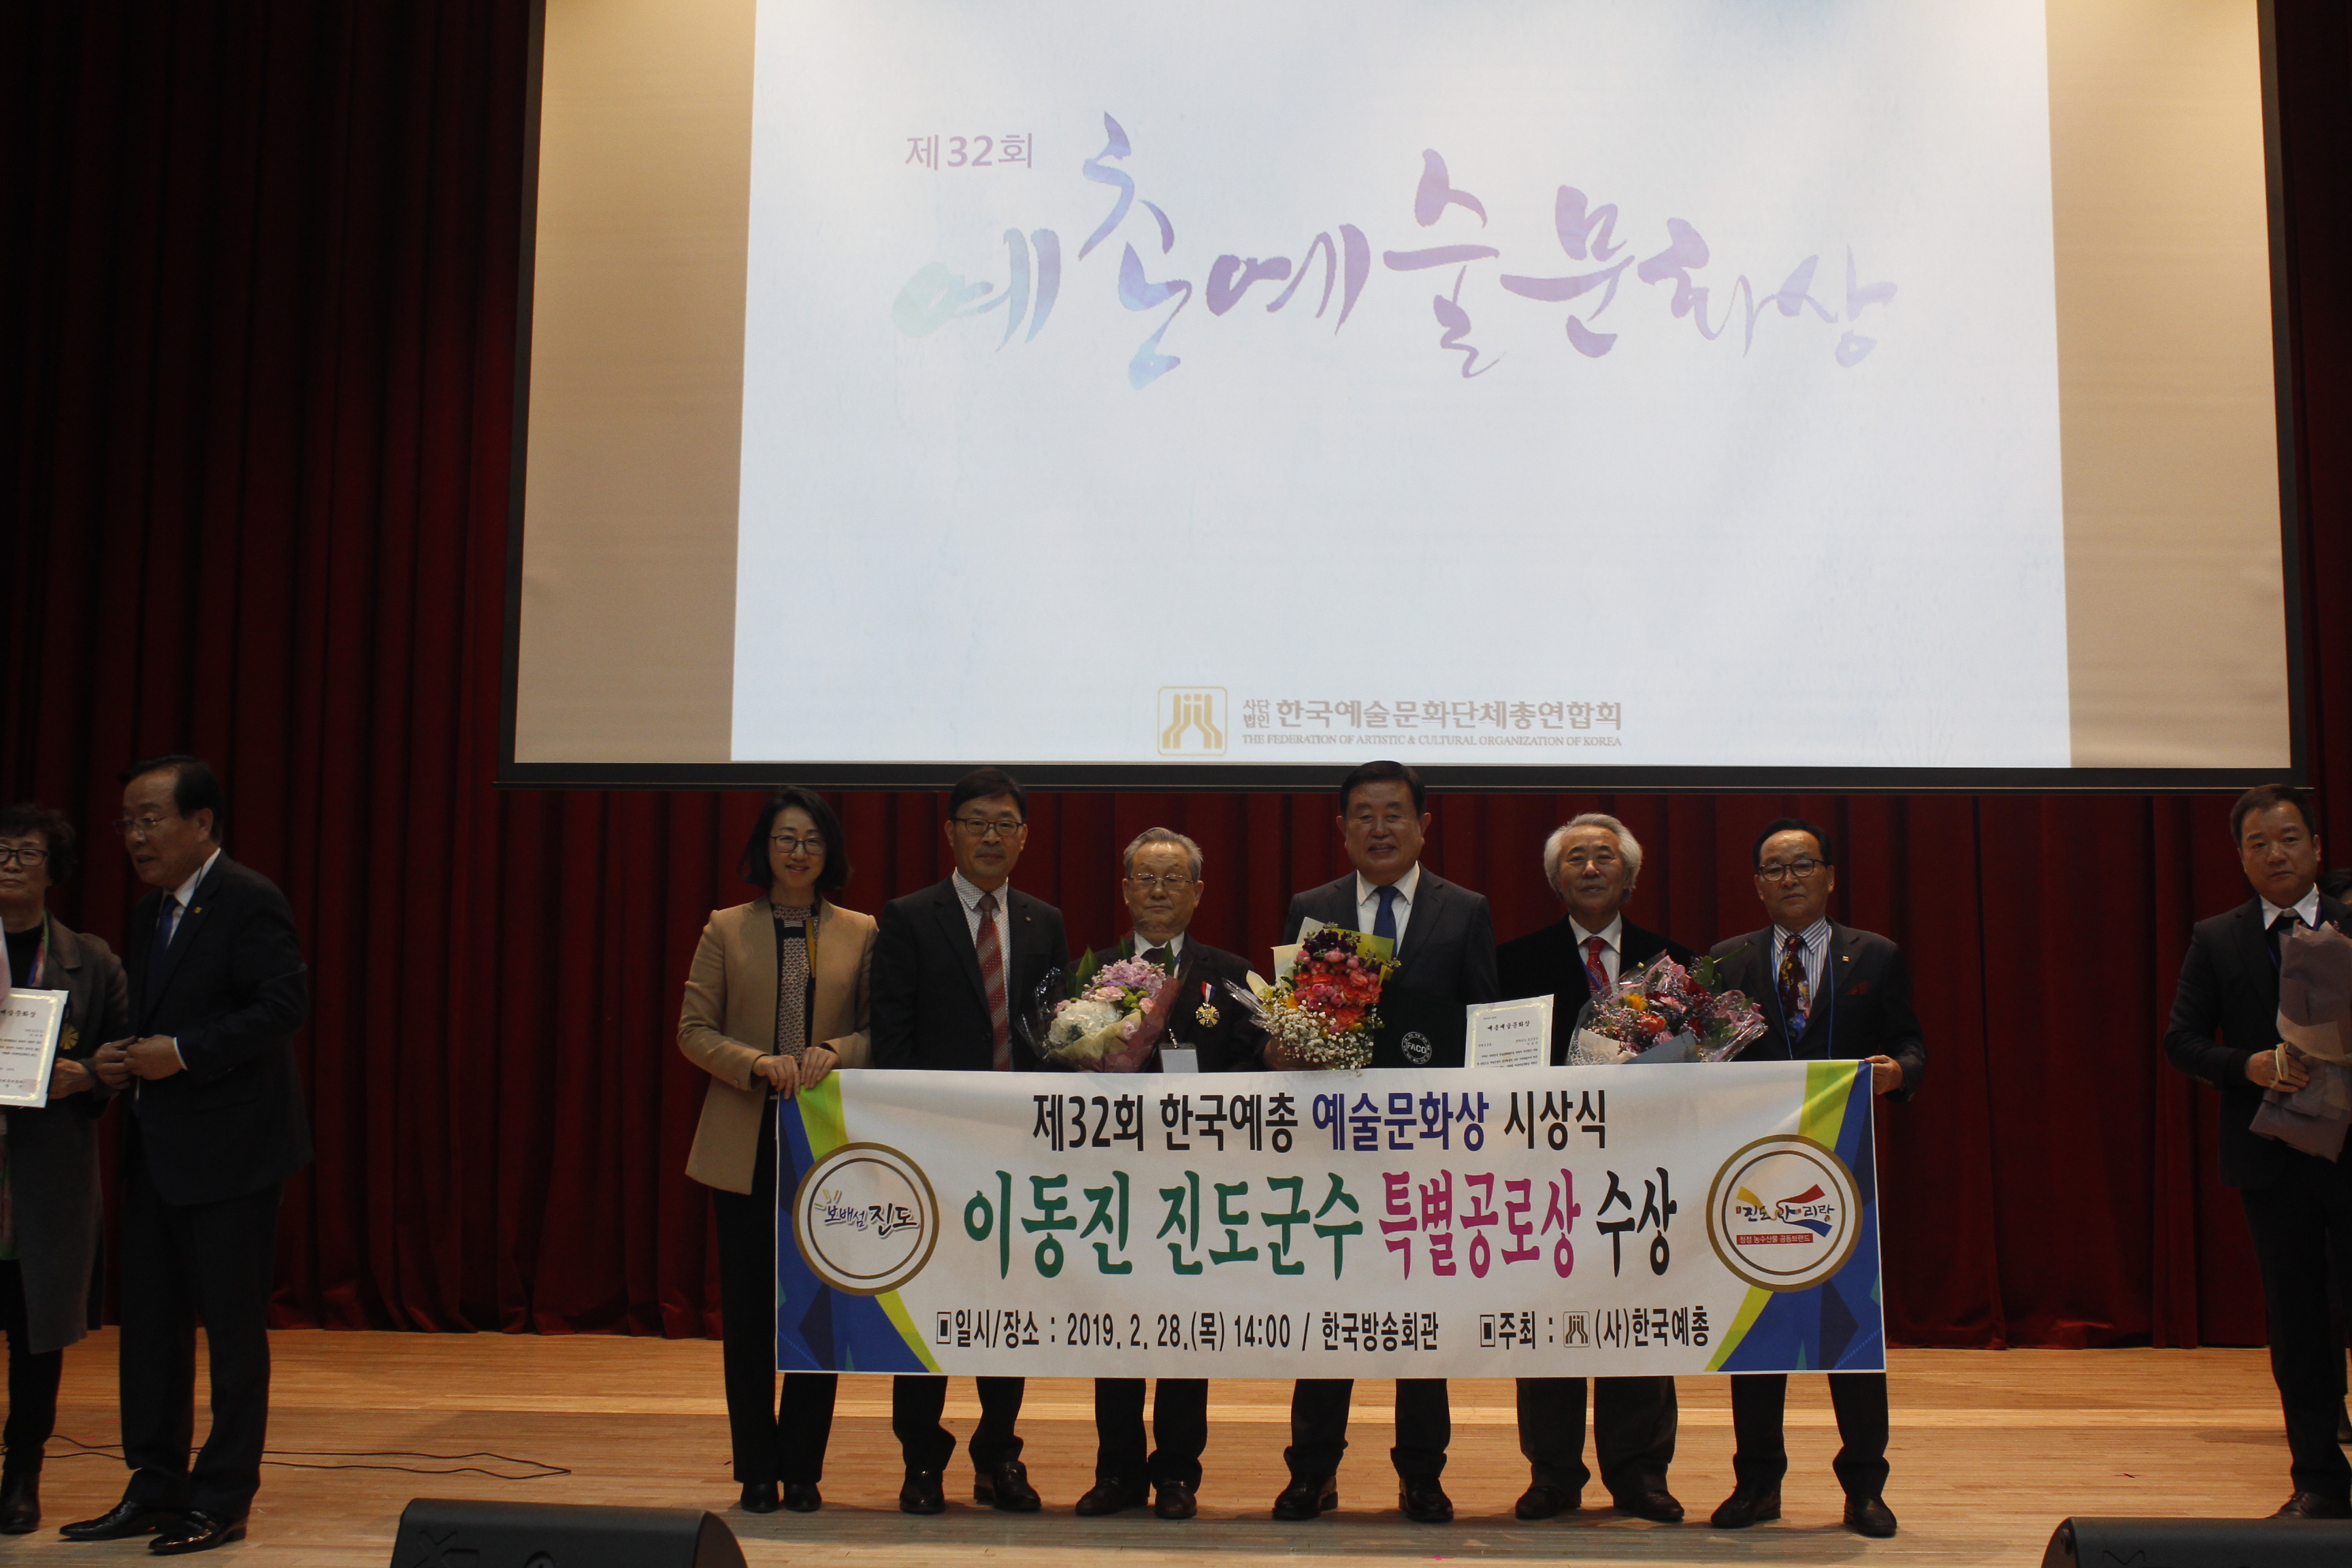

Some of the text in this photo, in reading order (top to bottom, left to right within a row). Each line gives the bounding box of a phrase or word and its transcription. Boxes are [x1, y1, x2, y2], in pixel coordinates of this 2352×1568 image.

[904, 132, 1033, 171] 제32회
[1243, 699, 1271, 714] 사단
[1243, 714, 1271, 728] 법인
[1276, 700, 1621, 730] 한국예술문화단체총연합회
[1242, 734, 1622, 747] THE FEDERATION OF ARTISTIC & CULTURAL ORGANIZATION OF KOREA
[1407, 1042, 1426, 1054] FACO
[1032, 1090, 1605, 1154] 제32회 한국예총 예술문화상 시상식
[824, 1203, 918, 1236] 보배섬 진도
[964, 1166, 1678, 1281] 이동진 진도군수 특별공로상 수상
[1739, 1235, 1811, 1244] 청정 농수산물 공동브랜드
[956, 1308, 1039, 1349] 일시/장소
[1234, 1313, 1291, 1348] 14:00
[1322, 1311, 1439, 1352] 한국방송회관
[1499, 1311, 1537, 1350] 주최
[1595, 1305, 1710, 1350] (사)한국예총
